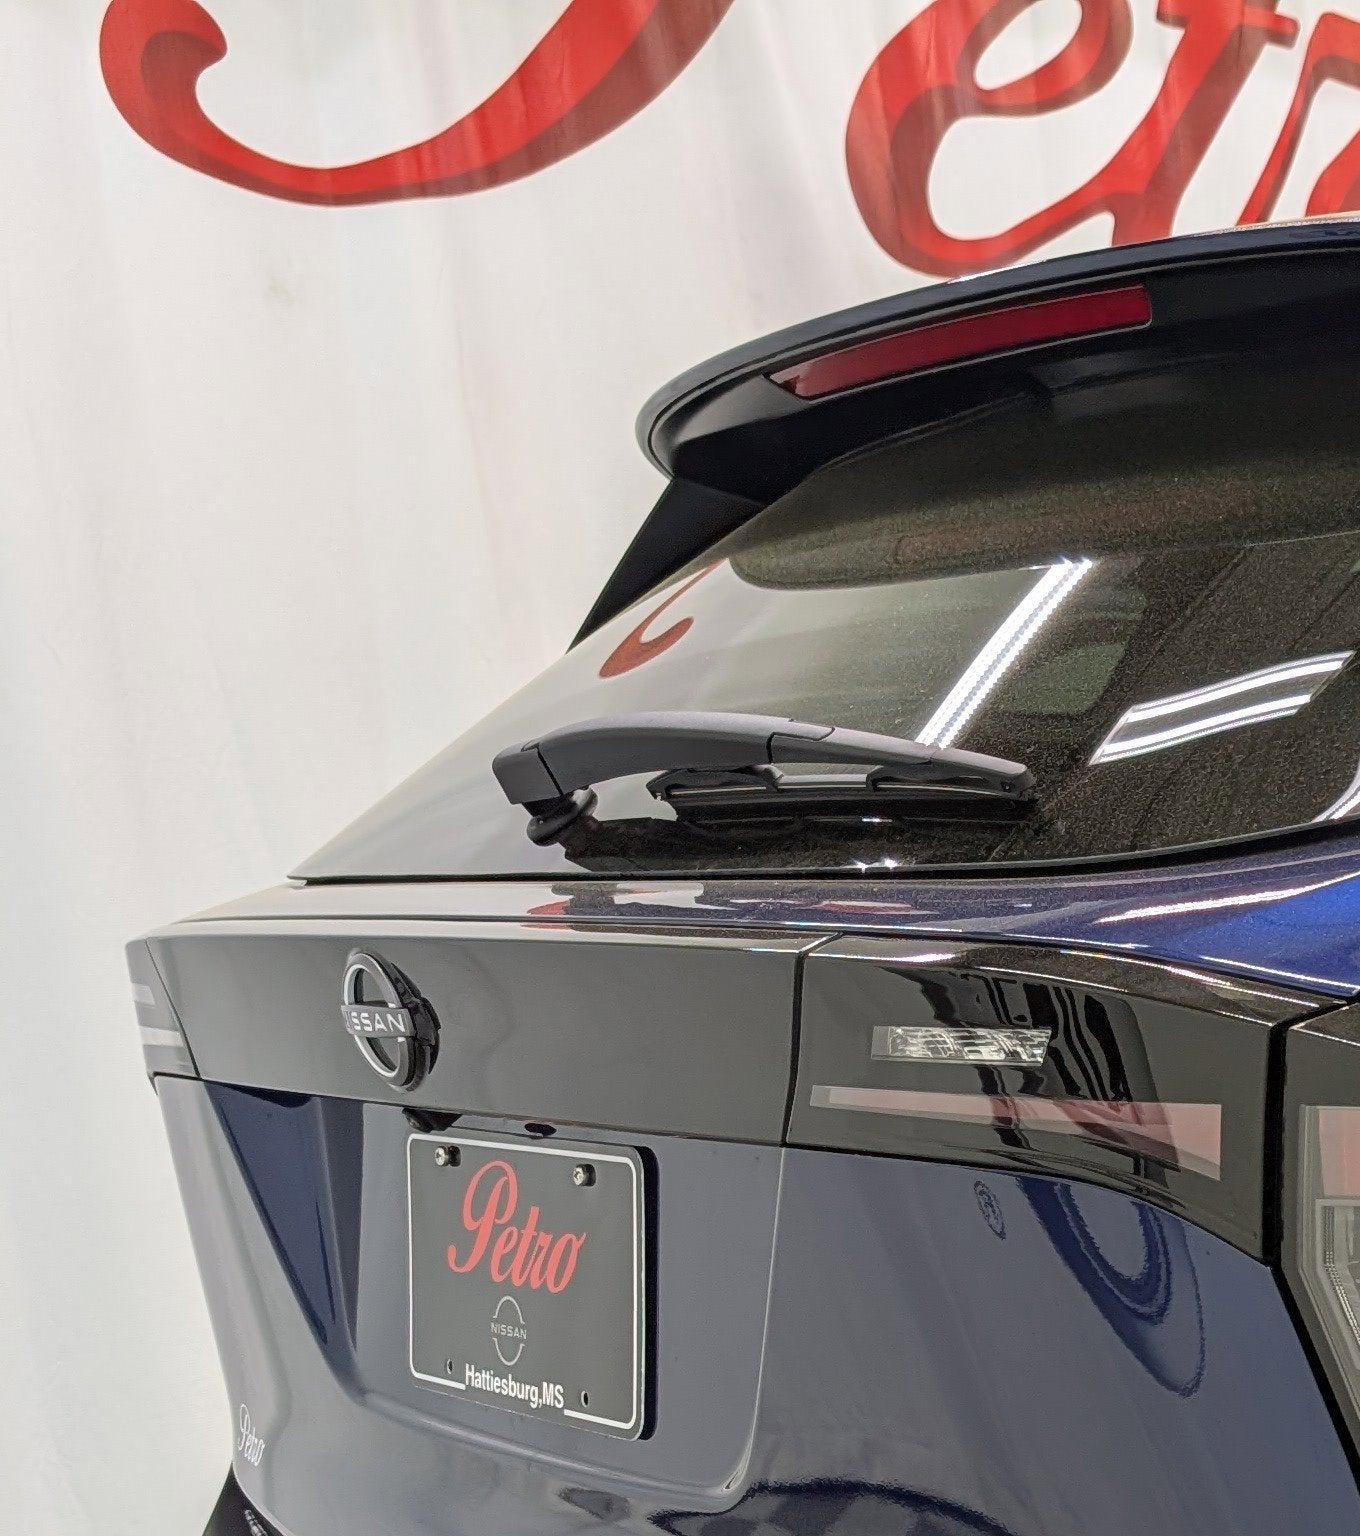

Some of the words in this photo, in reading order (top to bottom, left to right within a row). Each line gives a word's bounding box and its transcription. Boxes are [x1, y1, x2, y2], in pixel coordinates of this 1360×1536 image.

[447, 1160, 588, 1294] Petro
[491, 1322, 527, 1340] NISSAN
[238, 1403, 266, 1467] Petro
